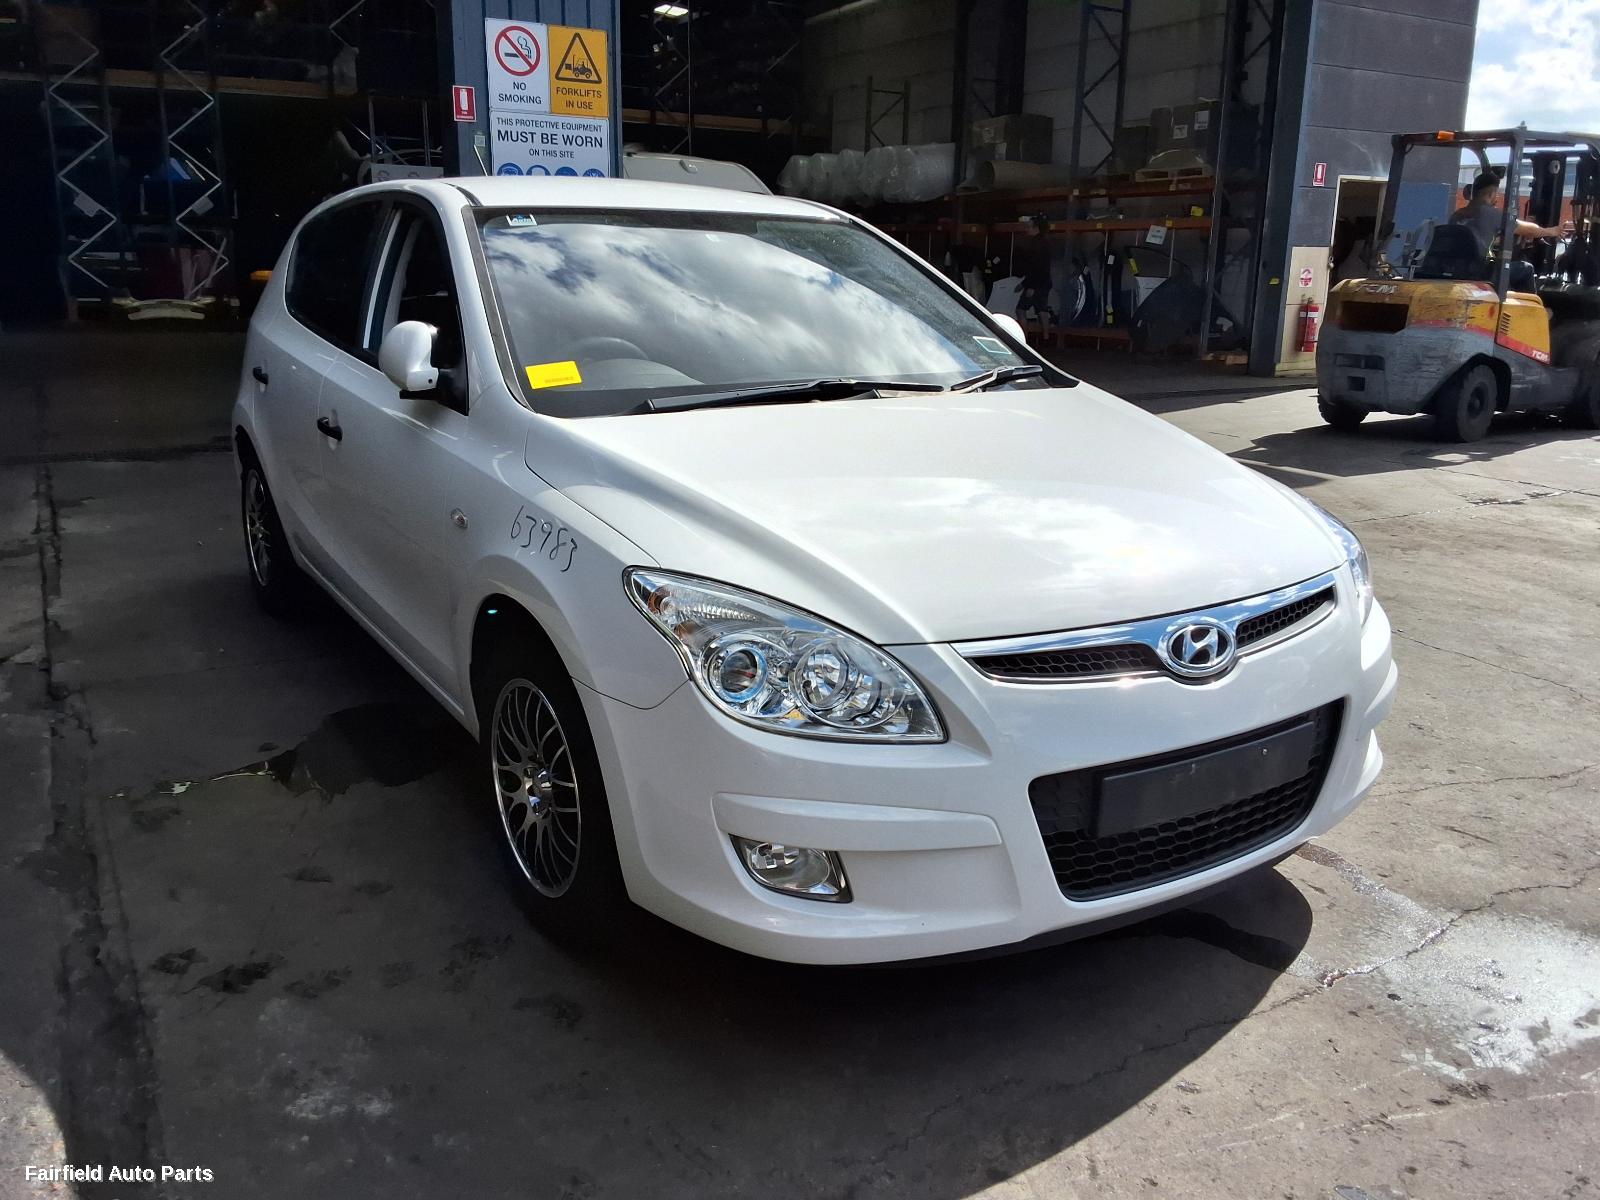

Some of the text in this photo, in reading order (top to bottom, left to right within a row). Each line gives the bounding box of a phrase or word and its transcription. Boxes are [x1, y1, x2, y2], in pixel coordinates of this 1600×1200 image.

[513, 82, 527, 91] NO
[556, 87, 602, 98] FORKLIFTS
[498, 93, 542, 105] SMOKING
[565, 100, 593, 110] IN USE
[496, 117, 603, 133] THIS PROTECTIVE EQUIPMENT
[497, 130, 603, 148] MUST BE WORN
[529, 148, 574, 159] ON THIS SITE
[1532, 349, 1549, 363] TCM
[511, 505, 578, 573] 63983
